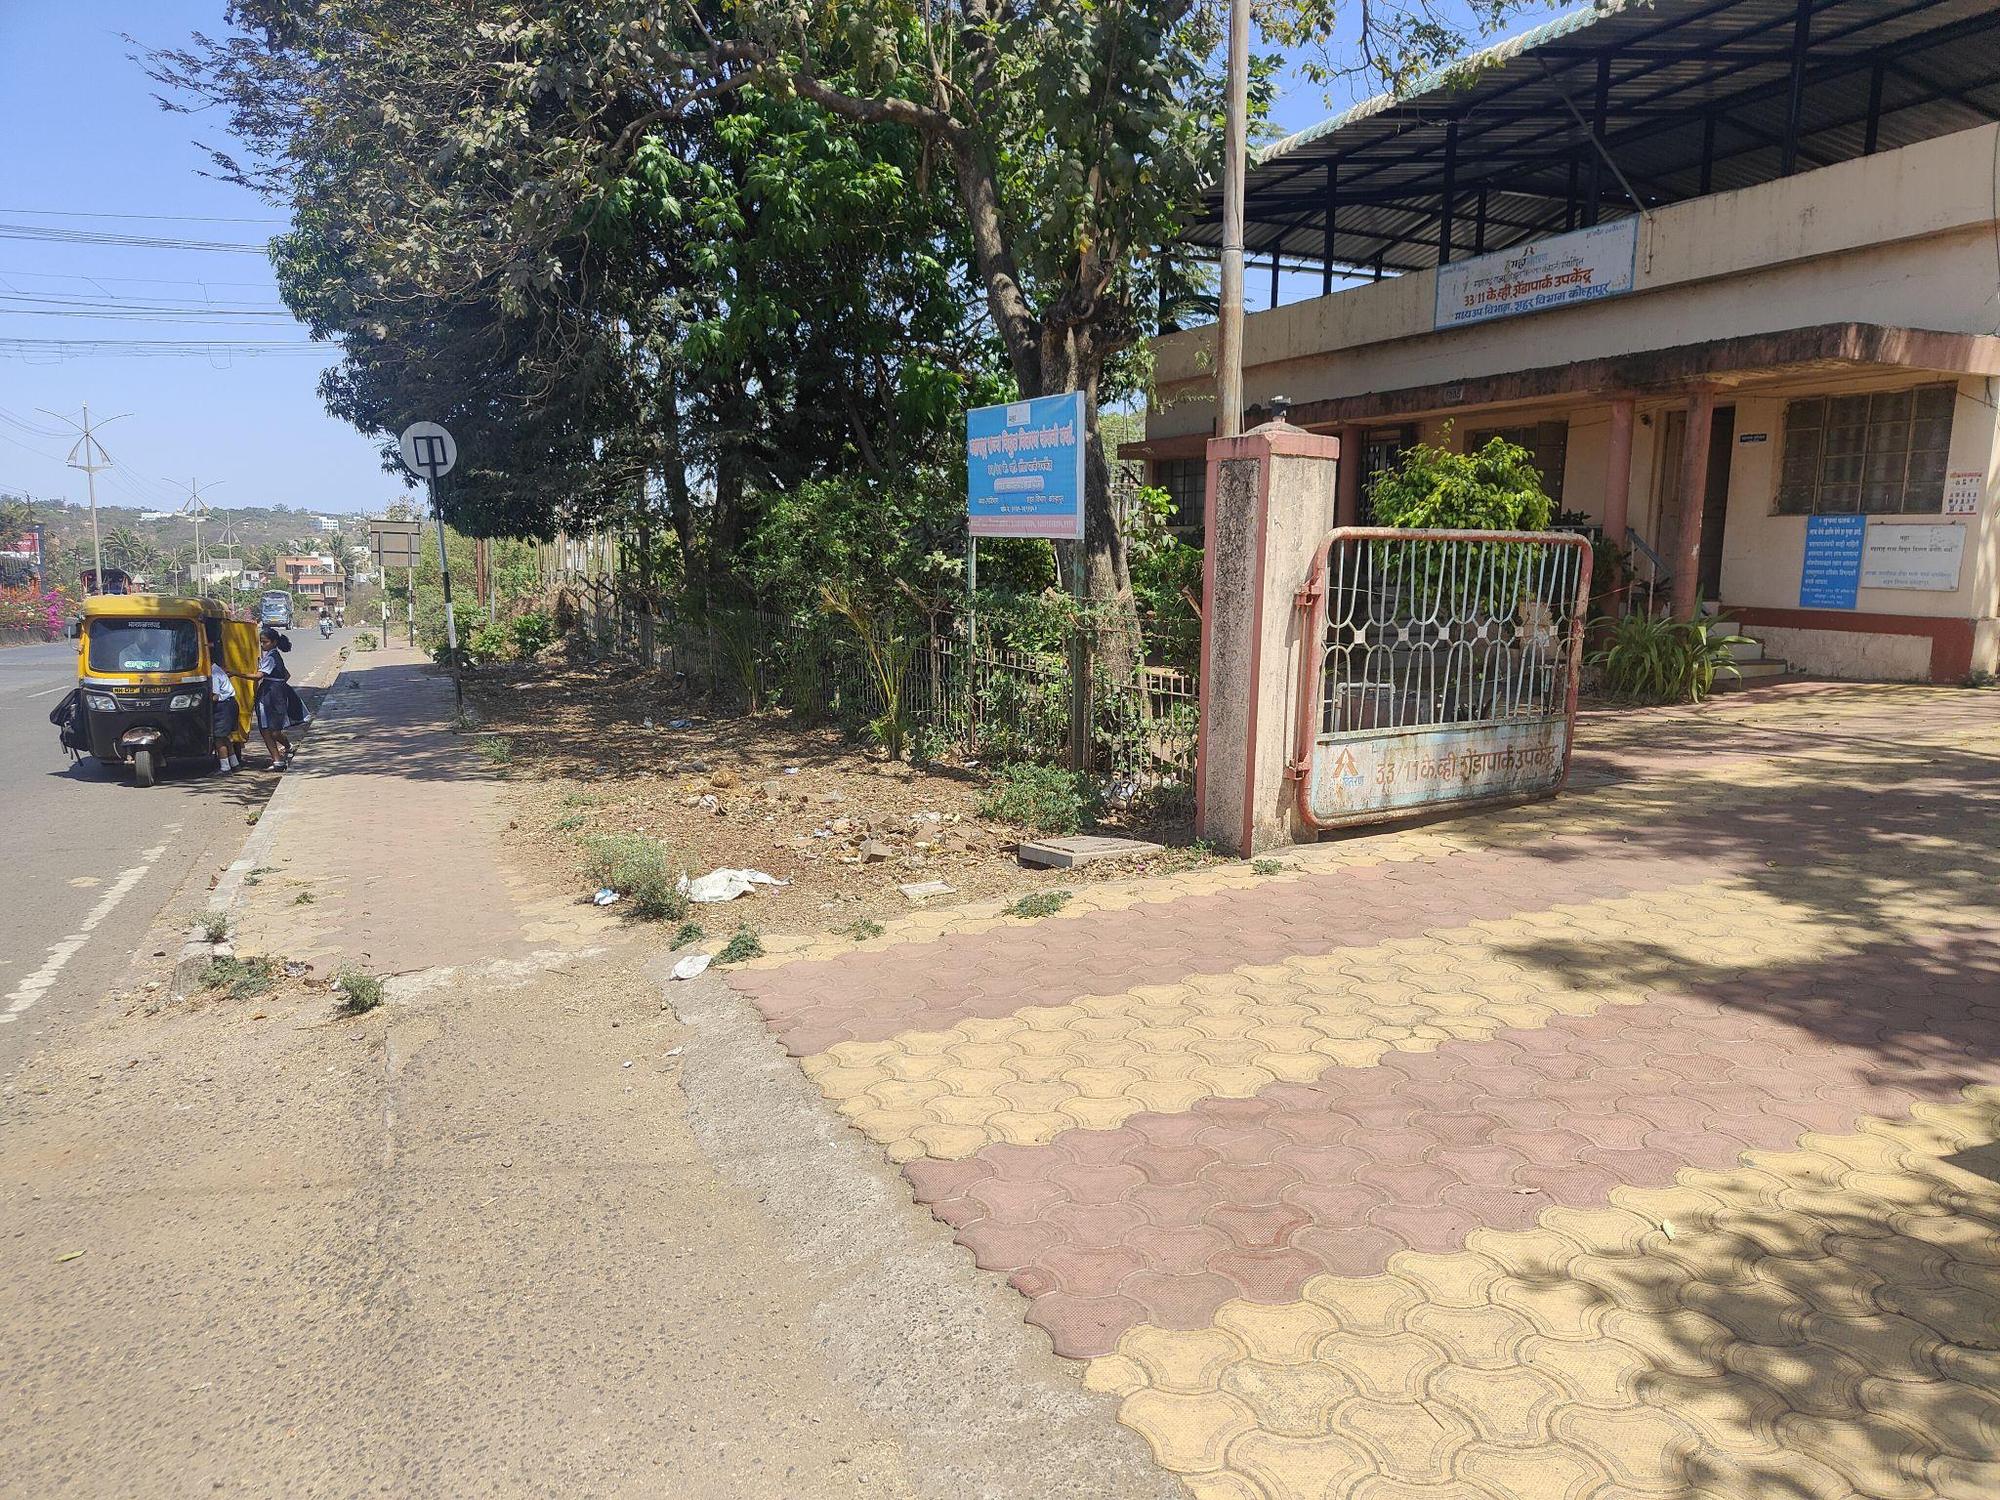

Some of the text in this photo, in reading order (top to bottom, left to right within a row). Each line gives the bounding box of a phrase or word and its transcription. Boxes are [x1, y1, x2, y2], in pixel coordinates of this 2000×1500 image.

[1555, 266, 1594, 288] उपकेंद्र
[1535, 290, 1566, 306] विभाग
[1568, 280, 1611, 299] कोल्हापूर
